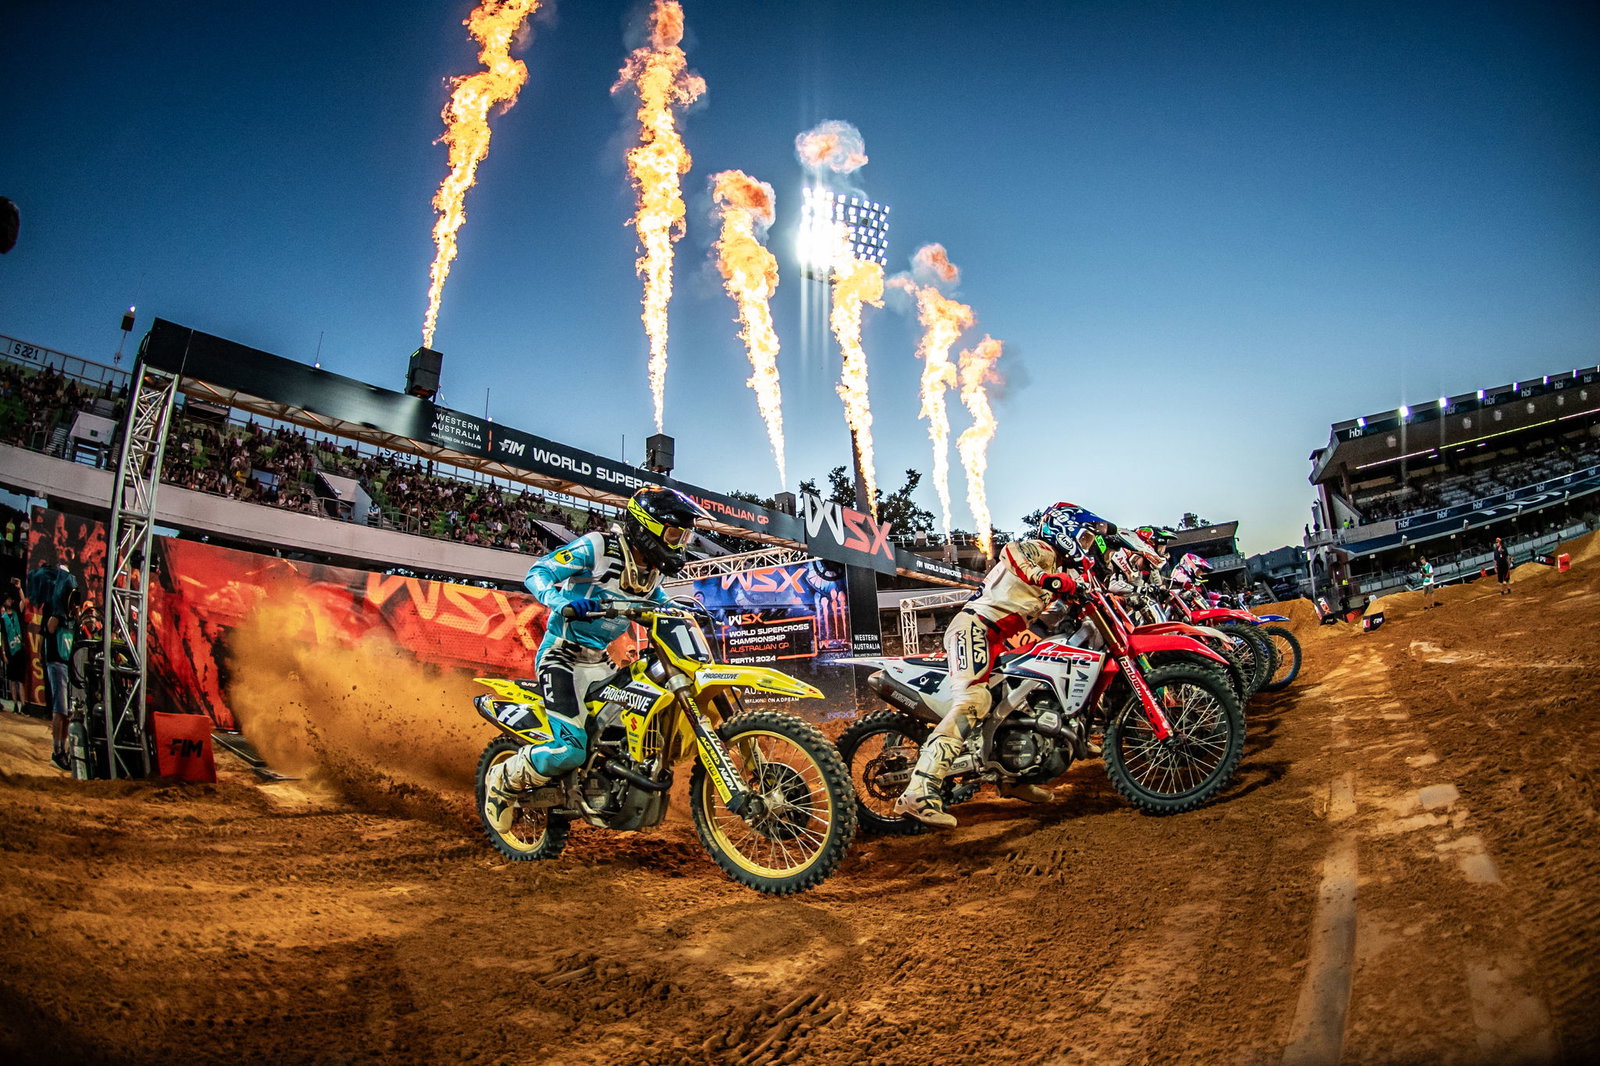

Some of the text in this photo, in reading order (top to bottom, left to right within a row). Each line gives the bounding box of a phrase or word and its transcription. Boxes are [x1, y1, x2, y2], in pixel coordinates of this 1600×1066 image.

[14, 343, 39, 360] S221
[431, 421, 482, 442] AUSTRALIA
[436, 413, 480, 432] WESTERN
[499, 438, 526, 457] FIM
[533, 447, 592, 476] WORLD
[757, 514, 770, 525] GP
[802, 491, 893, 560] WSX
[1060, 536, 1075, 549] Arai
[720, 567, 808, 594] WSX
[366, 571, 548, 652] WSX
[728, 612, 763, 626] WSX
[670, 624, 709, 656] 11
[729, 623, 810, 638] WORLD SUPERCROSS
[729, 634, 786, 646] CHAMPIONSHIP
[729, 642, 790, 653] AUSTRALIAN GP
[956, 628, 969, 671] MCR
[730, 655, 776, 664] PERTH 2024
[702, 672, 740, 680] PROGRESSIVE
[542, 672, 555, 704] FLY
[598, 685, 652, 713] PROGRESSIVE
[497, 703, 530, 727] 11
[165, 738, 203, 758] FIM
[708, 729, 749, 787] DUNLOP
